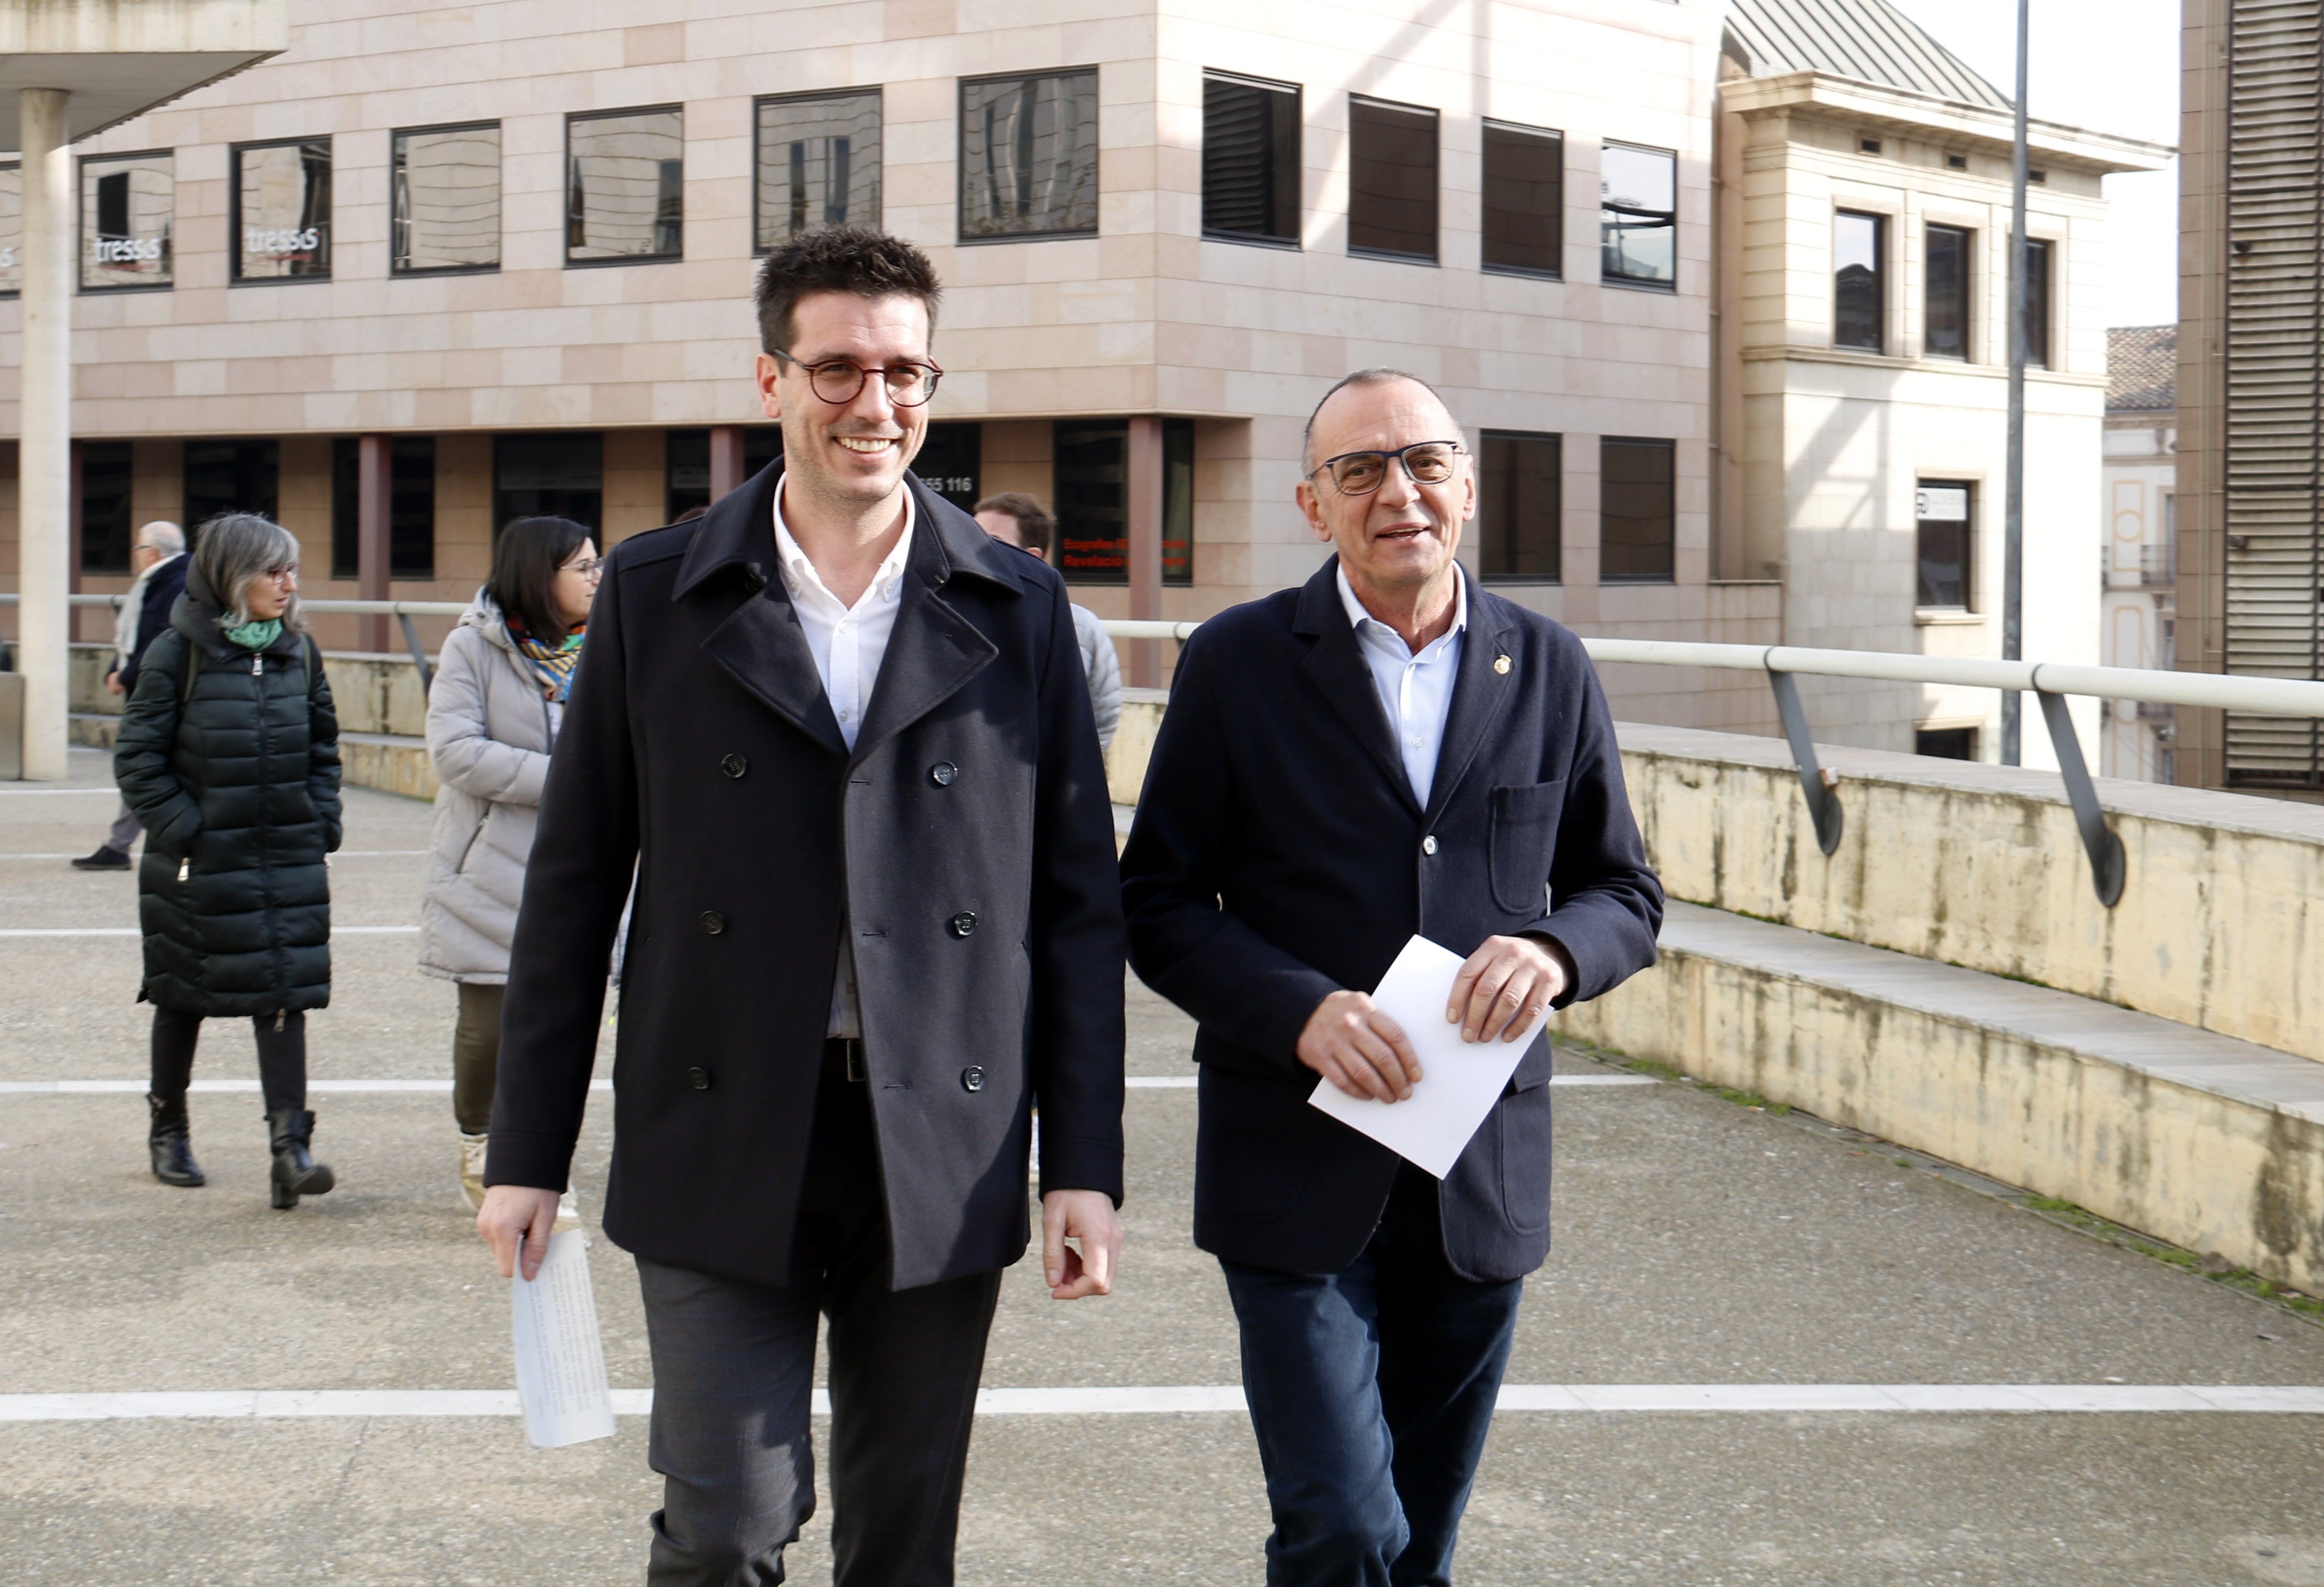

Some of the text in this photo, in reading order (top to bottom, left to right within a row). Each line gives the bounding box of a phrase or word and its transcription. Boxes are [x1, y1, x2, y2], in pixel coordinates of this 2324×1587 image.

[919, 477, 972, 492] 55 116
[1064, 554, 1123, 567] Revelació
